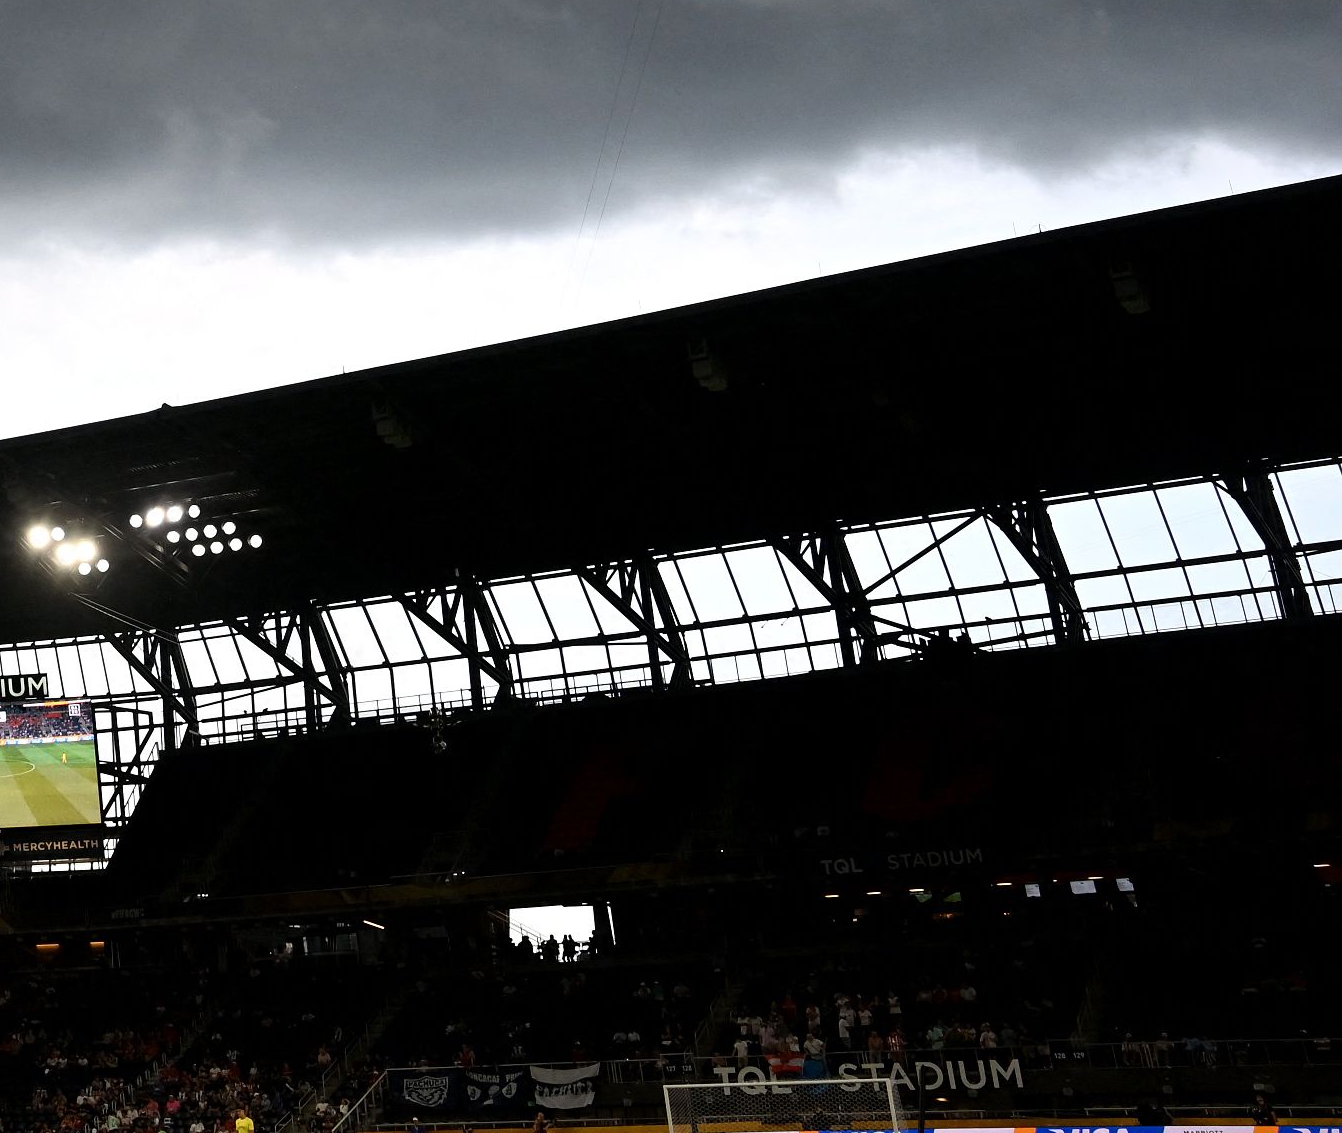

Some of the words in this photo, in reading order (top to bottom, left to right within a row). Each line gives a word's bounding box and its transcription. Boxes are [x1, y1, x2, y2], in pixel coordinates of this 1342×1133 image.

[12, 839, 99, 851] MERCYHEALTH
[820, 857, 864, 876] TQL
[887, 848, 983, 870] STADIUM
[713, 1066, 792, 1095] TQL
[838, 1058, 1024, 1092] STADIUM
